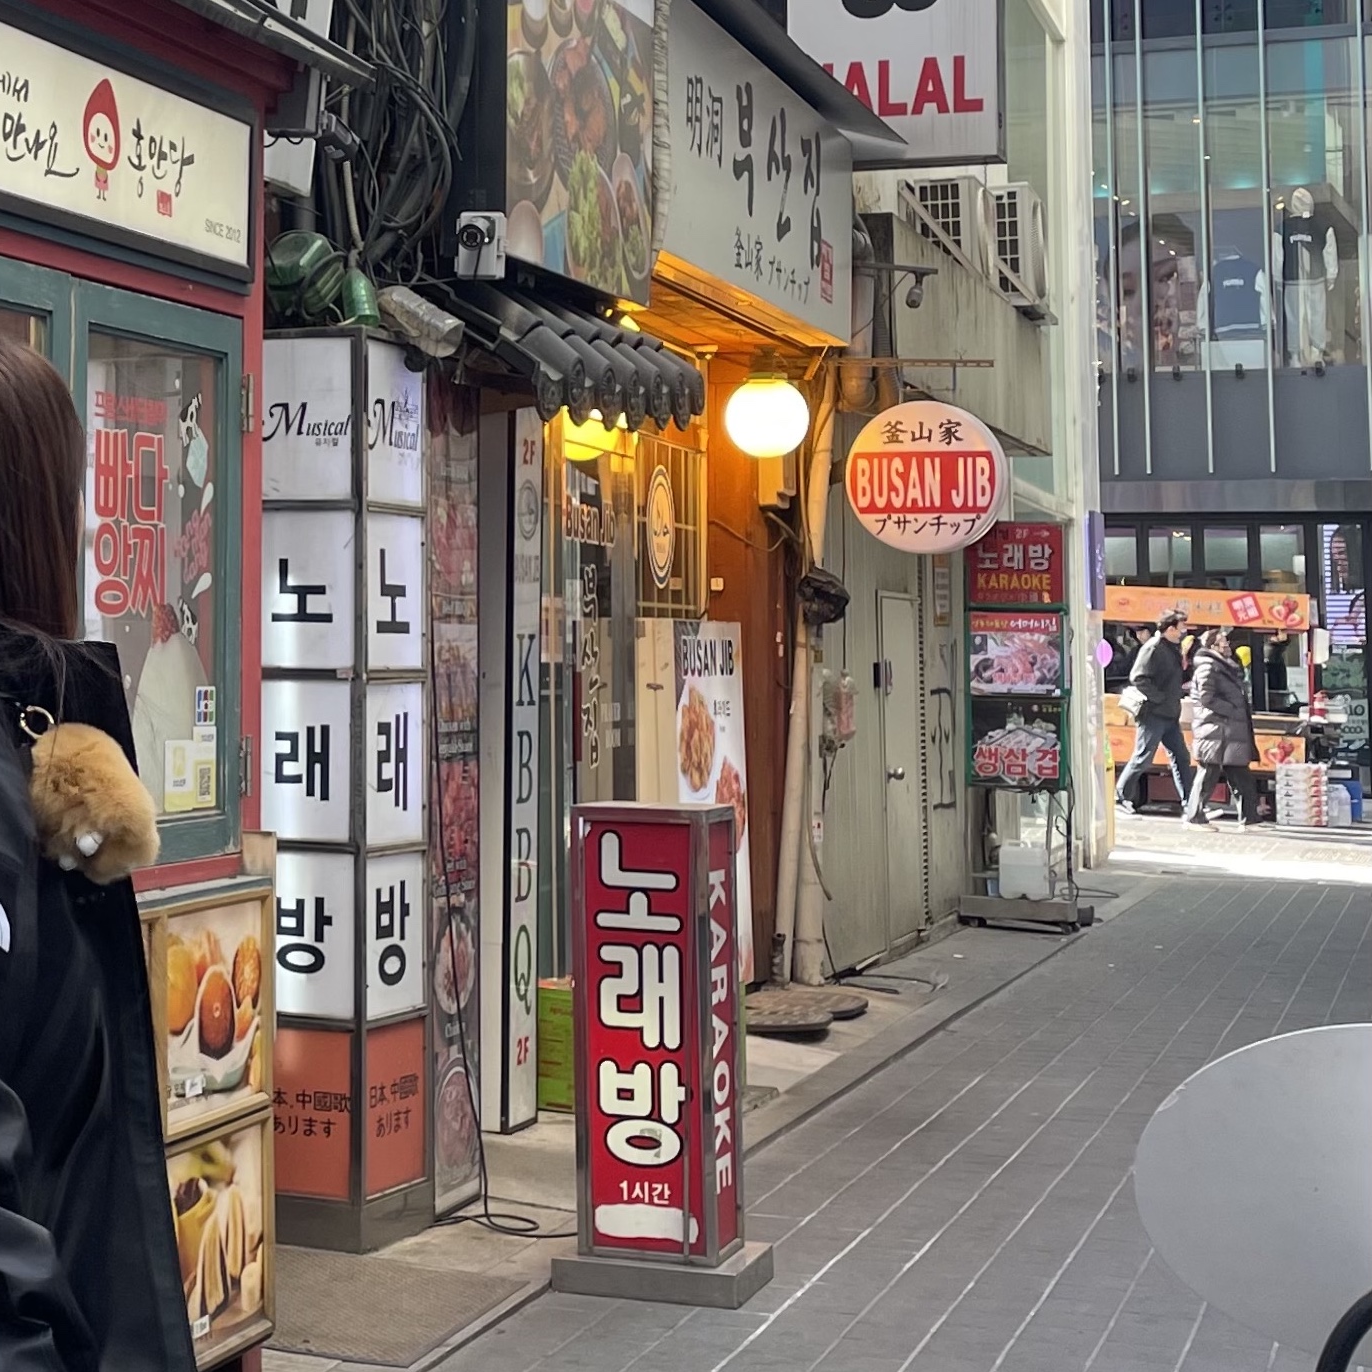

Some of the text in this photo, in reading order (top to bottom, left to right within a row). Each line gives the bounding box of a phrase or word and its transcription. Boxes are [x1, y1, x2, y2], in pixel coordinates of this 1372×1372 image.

[821, 55, 984, 117] ALAL
[2, 111, 79, 178] 만나요
[686, 74, 724, 169] 明洞
[128, 117, 195, 199] 홍만당
[732, 81, 822, 271] 부산집
[204, 218, 242, 244] SINCE 2012
[262, 400, 352, 443] Musical
[881, 419, 965, 446] 釜山家
[523, 440, 536, 466] 2F
[857, 456, 992, 509] BUSAN JIB
[565, 494, 616, 549] Busan Jib
[875, 513, 982, 536] プサンチップ
[977, 543, 1053, 571] 노래방
[977, 572, 1051, 590] KARAOKE
[581, 564, 600, 770] 부산집
[682, 638, 734, 678] BUSAN JIB
[271, 557, 334, 975] 노래방
[375, 547, 411, 987] 노래방
[974, 747, 1059, 779] 생삼겹
[594, 828, 692, 1167] 노래방
[516, 1036, 530, 1066] 2F
[708, 868, 733, 1196] KARAOKE
[376, 1107, 412, 1138] あります
[618, 1180, 672, 1205] 1시간
